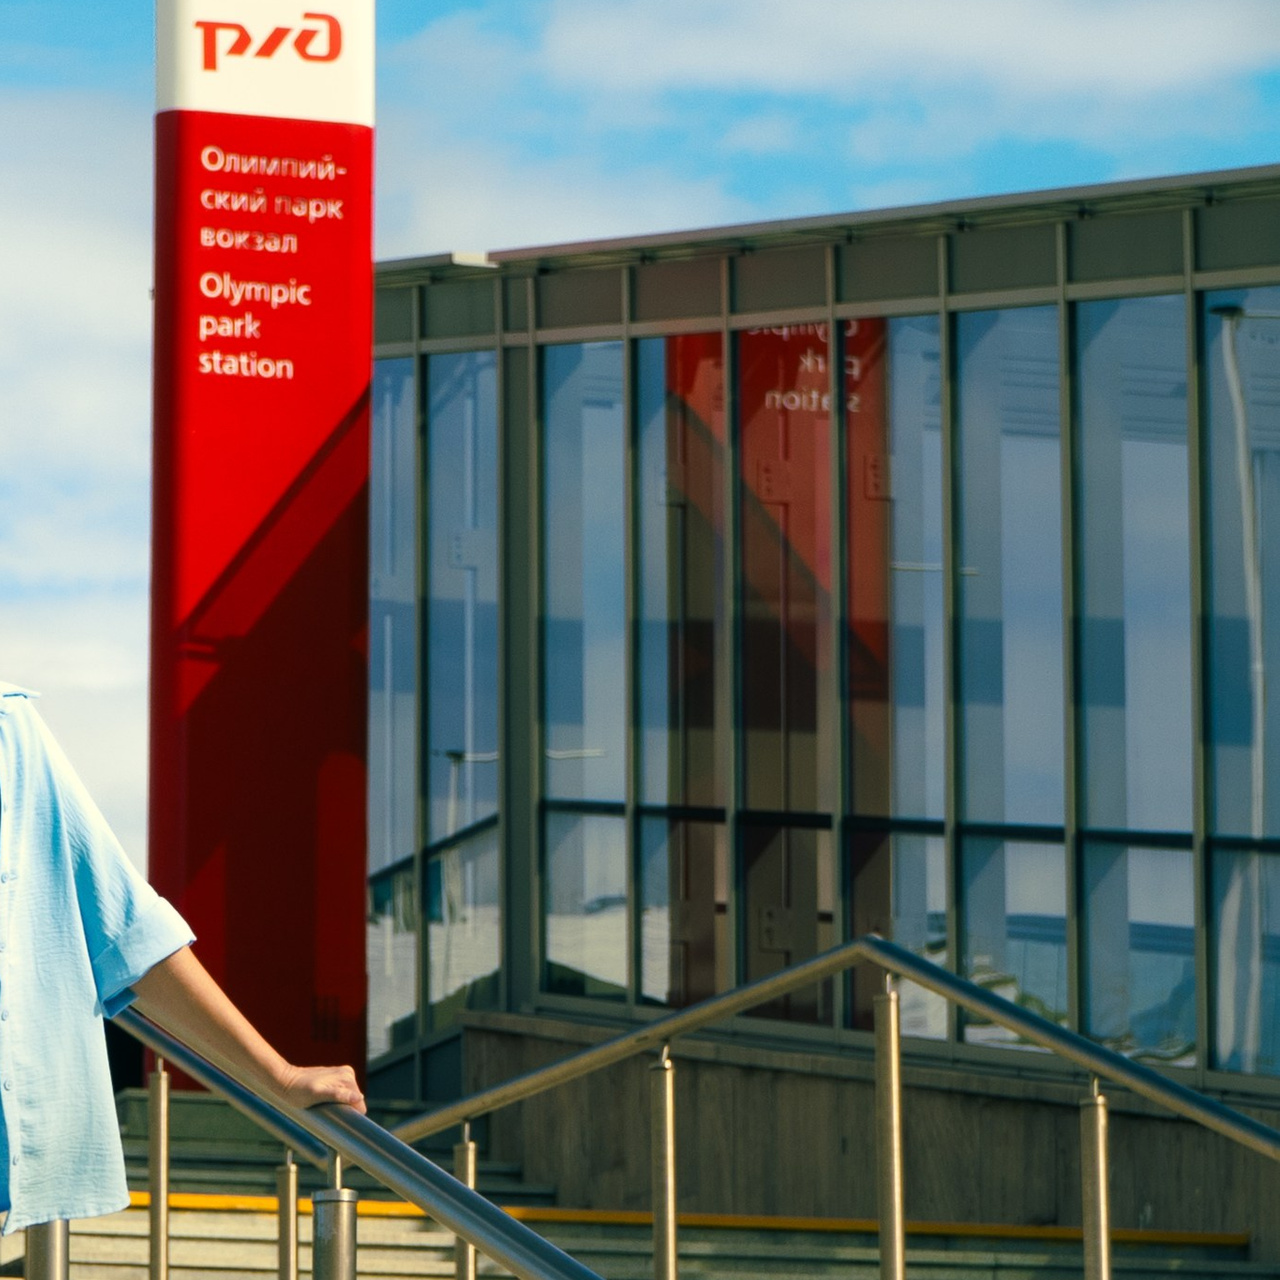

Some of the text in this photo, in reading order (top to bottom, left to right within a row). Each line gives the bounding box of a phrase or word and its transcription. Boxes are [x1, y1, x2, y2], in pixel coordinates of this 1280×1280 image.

[200, 146, 347, 181] Олимпий-
[200, 188, 344, 224] ский парк
[200, 227, 298, 254] вокзал
[199, 272, 312, 309] Olympic
[199, 312, 261, 341] park
[198, 350, 293, 380] station
